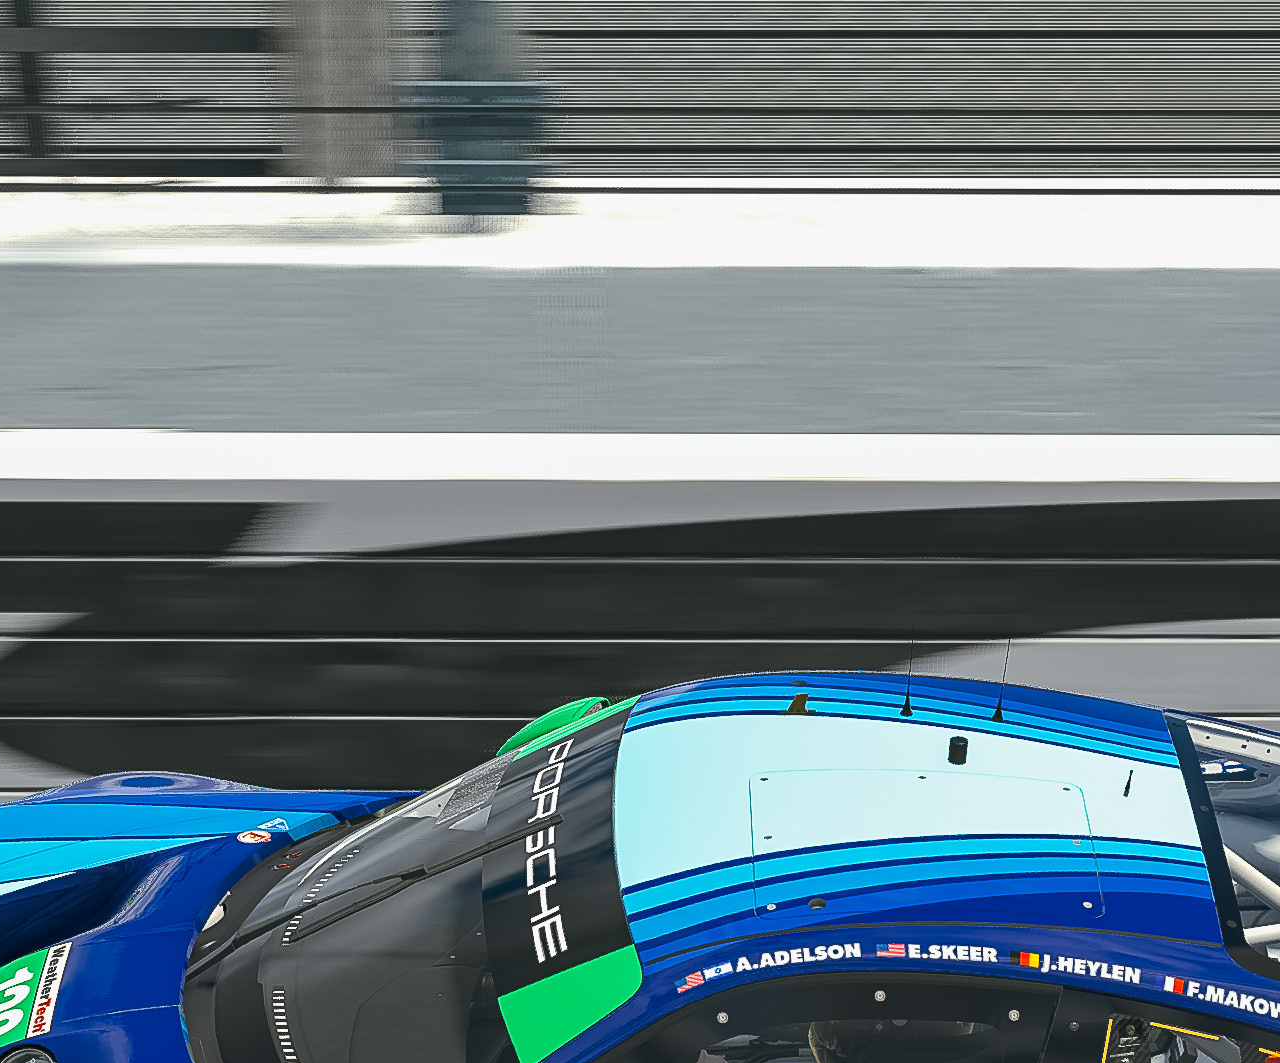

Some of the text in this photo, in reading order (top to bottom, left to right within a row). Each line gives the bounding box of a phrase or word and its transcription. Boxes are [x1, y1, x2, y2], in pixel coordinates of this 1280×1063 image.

[525, 738, 575, 963] PORSCHE
[736, 943, 861, 972] A.ADELSON
[908, 944, 998, 963] E.SKEER
[1041, 954, 1141, 984] J.HEYLEN
[32, 945, 67, 1034] WeatherTech
